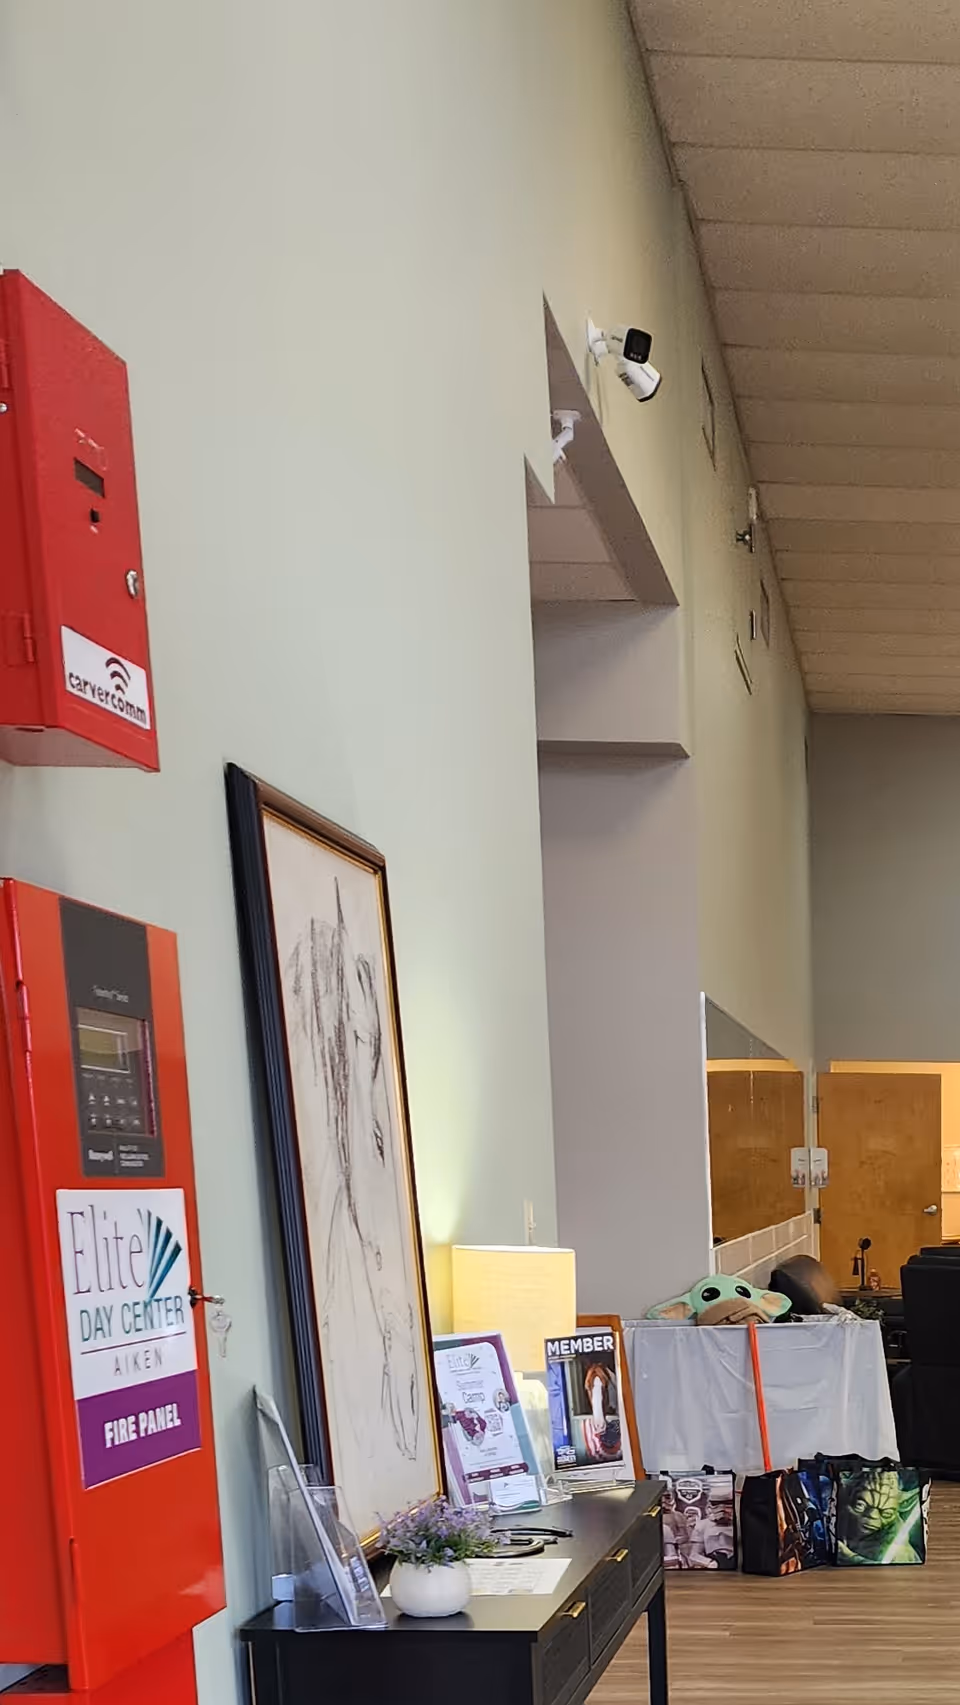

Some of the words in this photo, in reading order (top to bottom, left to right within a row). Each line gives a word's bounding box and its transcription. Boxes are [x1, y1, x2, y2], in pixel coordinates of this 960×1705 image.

[69, 672, 146, 724] carvercomm
[67, 1205, 144, 1295] Elite
[80, 1304, 114, 1343] DAY
[121, 1295, 184, 1335] CENTER
[113, 1348, 164, 1376] AIKEN
[547, 1335, 615, 1356] MEMBER
[104, 1415, 138, 1448] FIRE
[139, 1403, 182, 1438] PANEL
